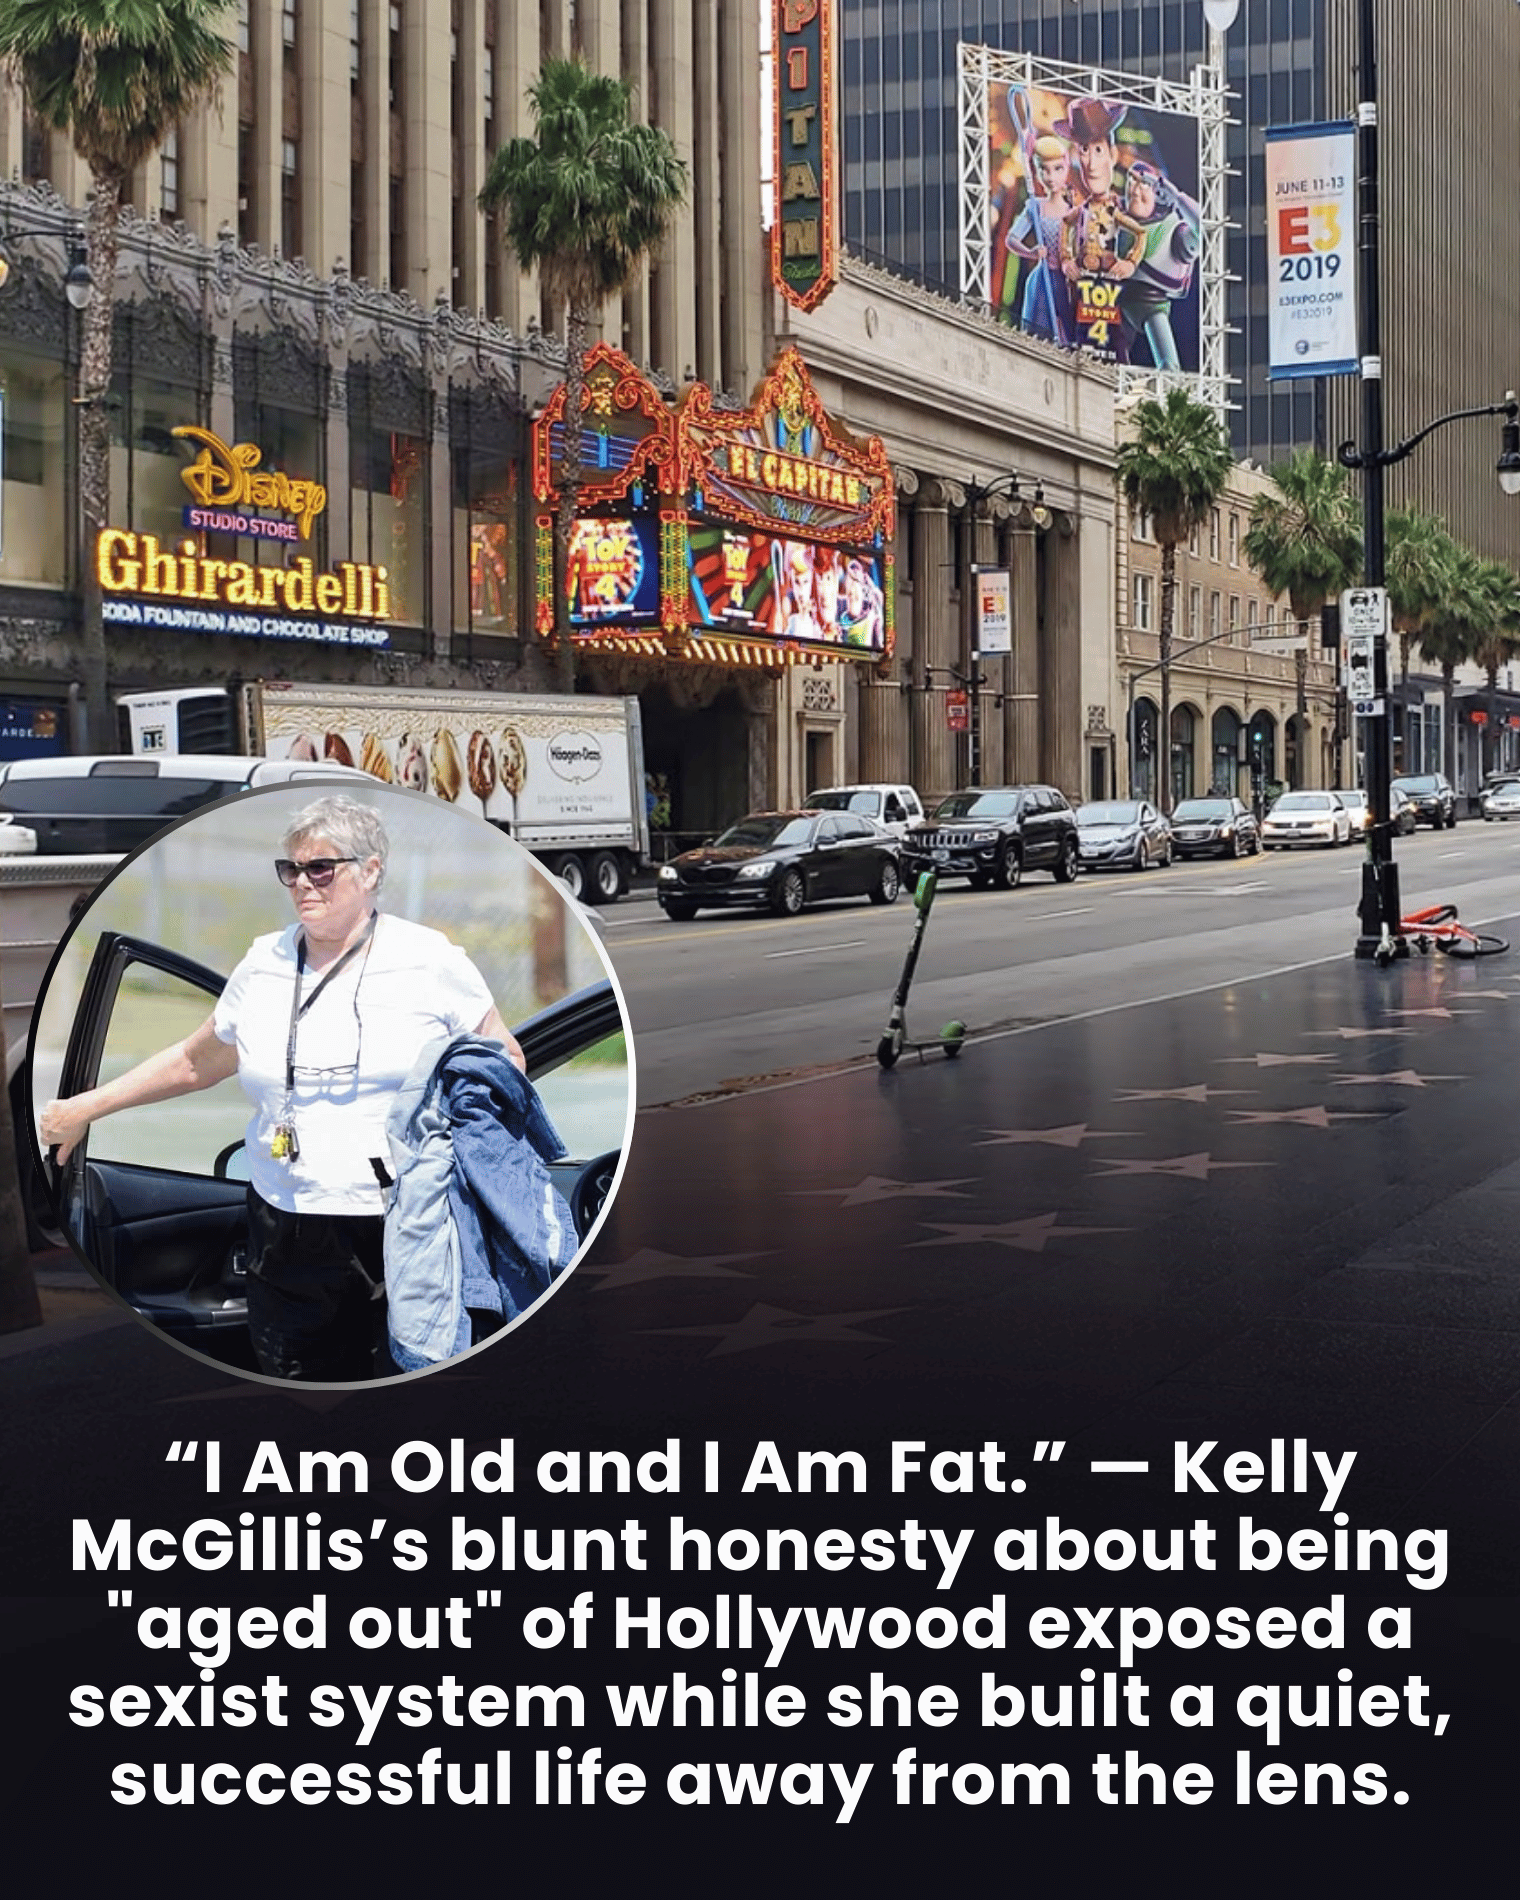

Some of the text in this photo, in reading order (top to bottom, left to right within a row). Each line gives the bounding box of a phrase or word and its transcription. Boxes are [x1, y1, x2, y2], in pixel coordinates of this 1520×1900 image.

[1275, 176, 1344, 196] JUNE 11-13
[1278, 203, 1341, 255] E3
[1279, 254, 1341, 282] 2019
[1077, 280, 1122, 307] TOY
[1278, 291, 1343, 306] E3EXPO.COM
[1088, 320, 1109, 346] 4
[731, 445, 860, 505] EL CAPITAN
[189, 509, 298, 541] STUDIO STORE
[582, 535, 629, 560] TOY
[98, 528, 391, 618] Ghirardelli
[595, 573, 616, 598] 4
[102, 602, 389, 646] SODA FOUNTAIN AND CHOCOLATE SHOP
